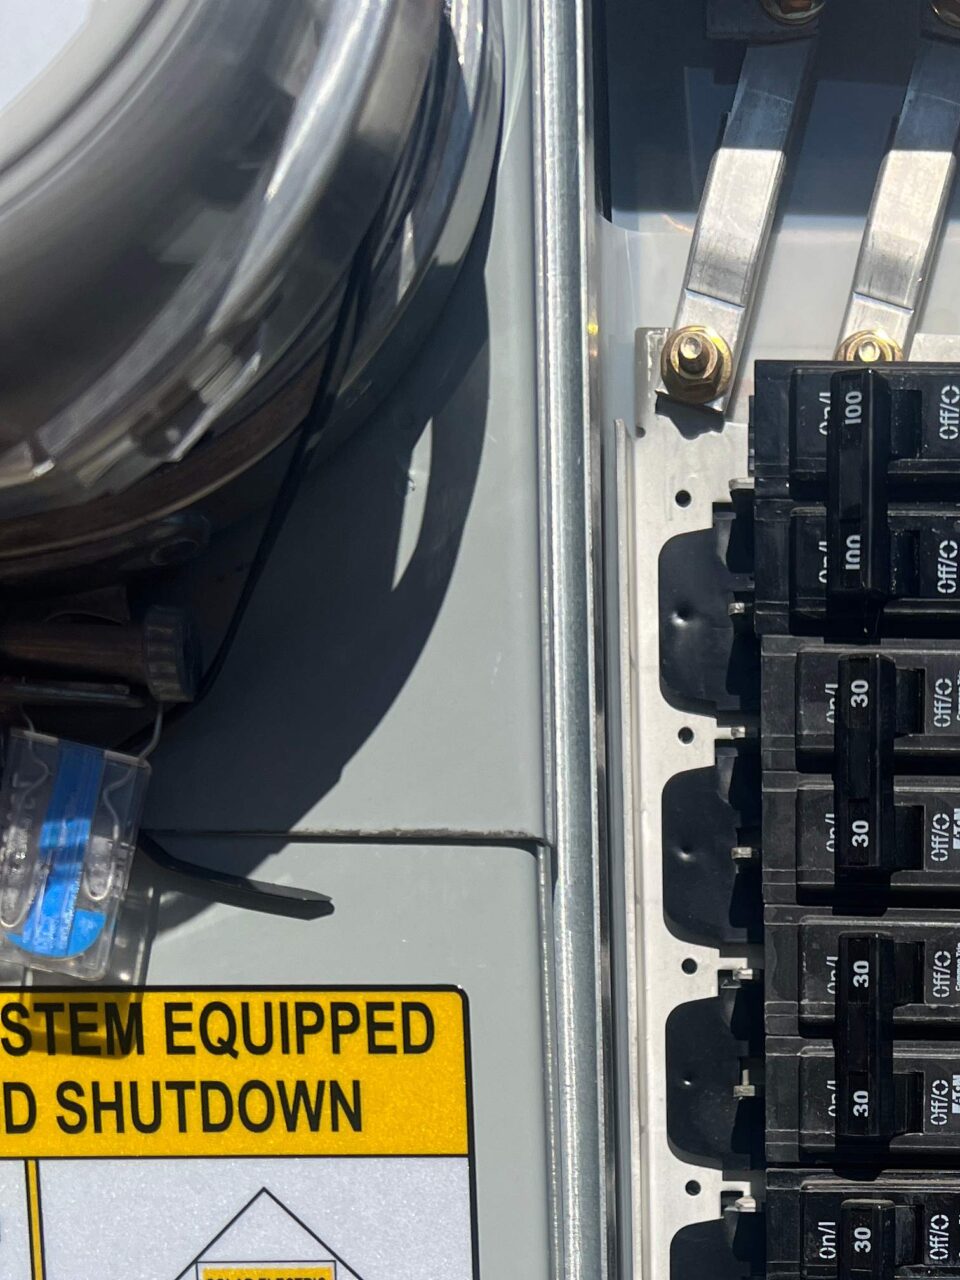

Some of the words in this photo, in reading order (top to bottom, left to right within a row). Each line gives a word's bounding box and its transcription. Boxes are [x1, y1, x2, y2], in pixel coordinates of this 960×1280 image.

[845, 391, 862, 424] 100
[851, 679, 868, 707] 30
[852, 820, 869, 847] 30
[853, 960, 869, 987] 30
[165, 1000, 435, 1058] EQUIPPED
[56, 1079, 362, 1134] SHUTDOWN
[853, 1090, 868, 1117] 30
[854, 1227, 871, 1253] 30
